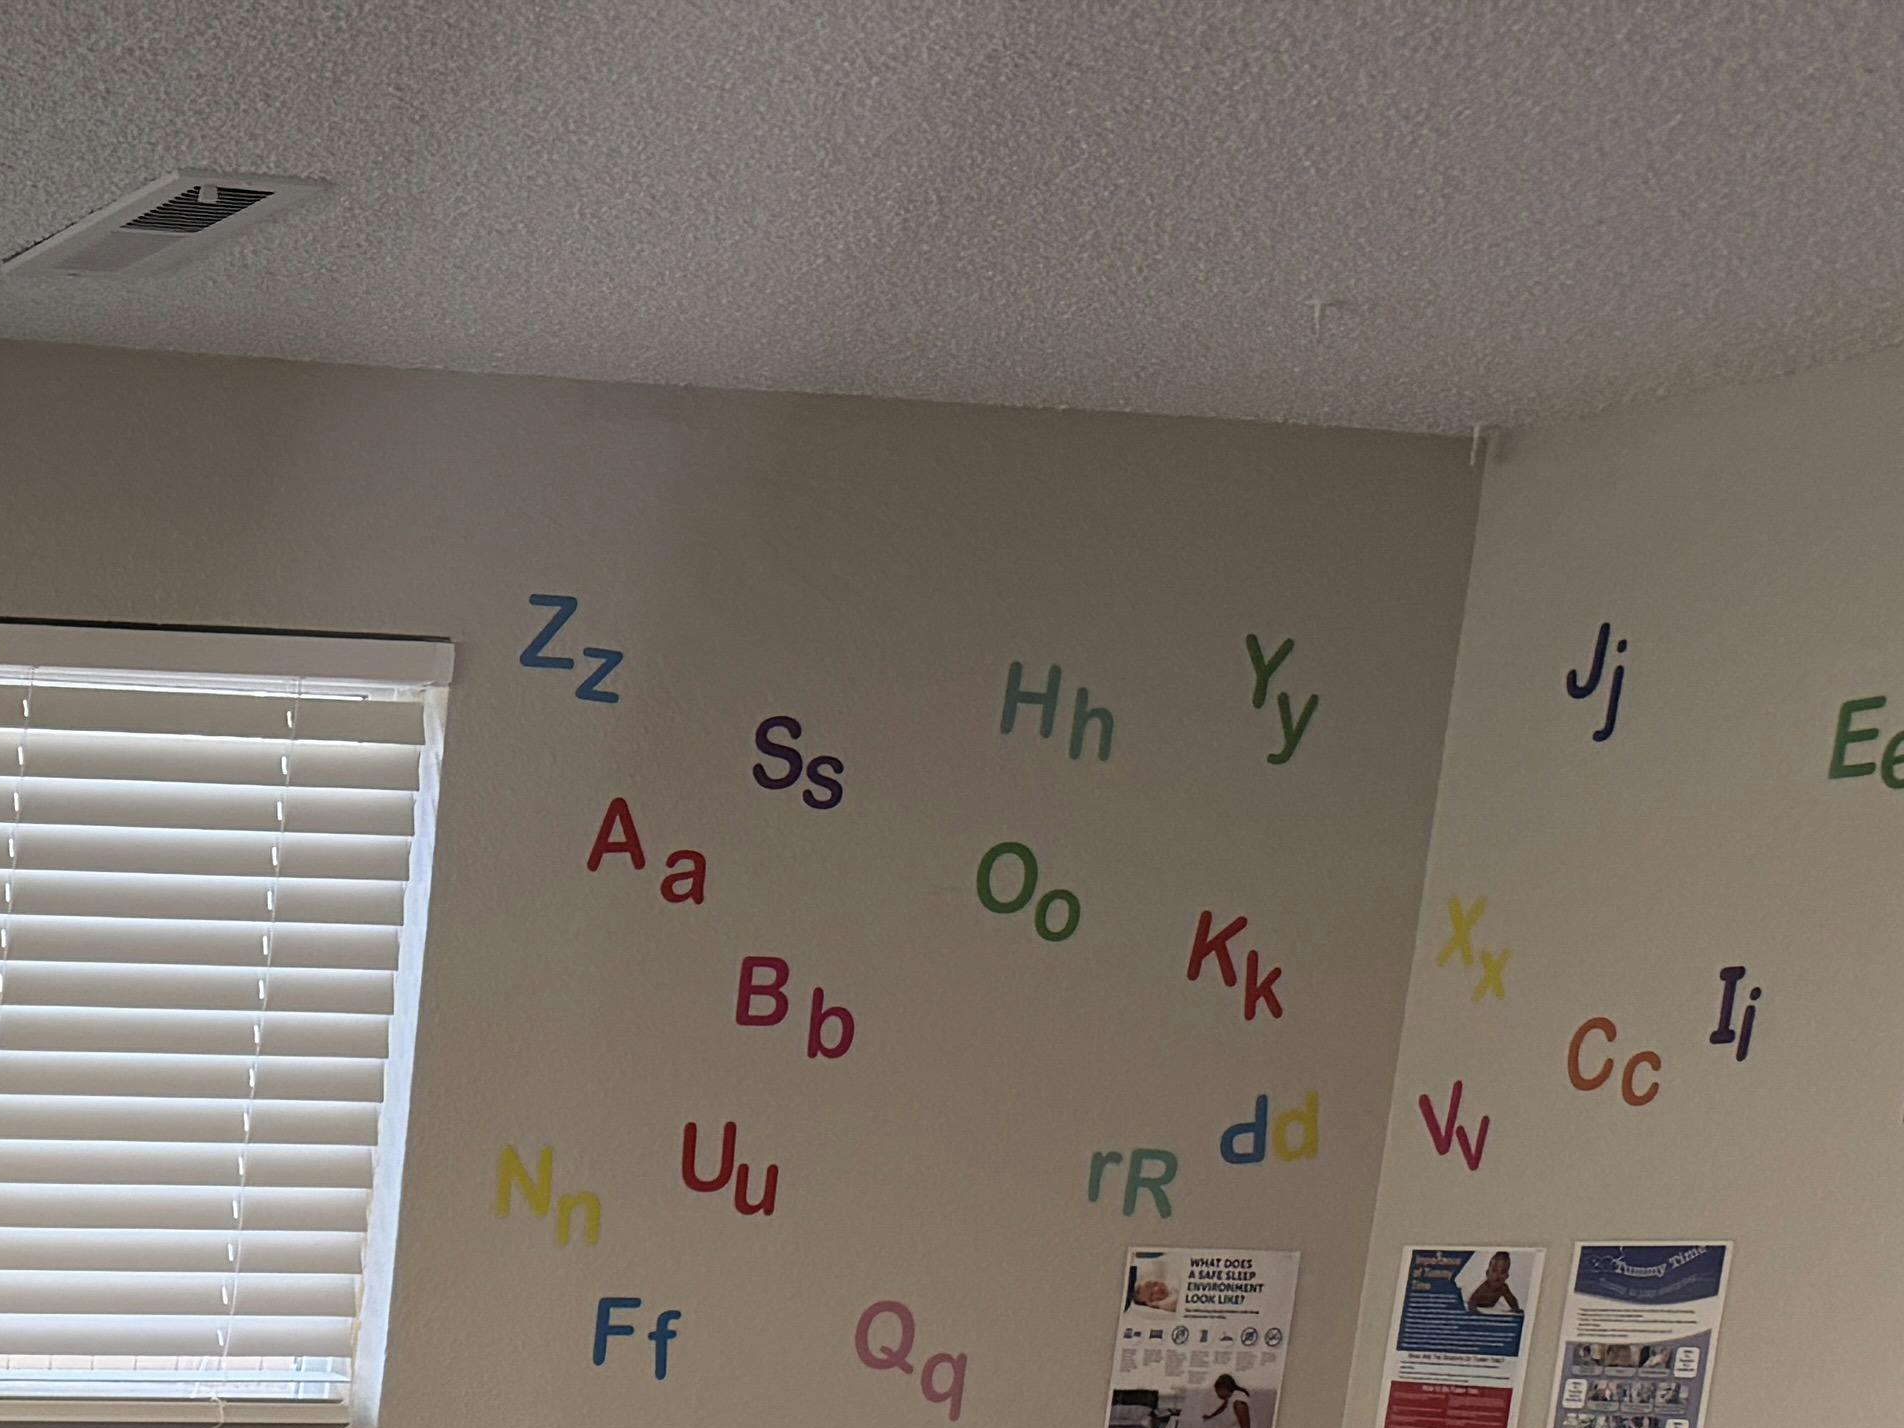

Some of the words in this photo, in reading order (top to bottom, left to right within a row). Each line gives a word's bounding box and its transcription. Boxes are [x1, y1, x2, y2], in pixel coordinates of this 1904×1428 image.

[1190, 1258, 1222, 1269] WHAT
[1224, 1259, 1253, 1269] DOES
[1614, 1258, 1667, 1278] Tummy
[1188, 1270, 1196, 1279] A
[1198, 1270, 1223, 1280] SAFE
[1225, 1271, 1256, 1281] SLEEP
[1187, 1282, 1264, 1293] ENVIRONMENT
[1185, 1294, 1215, 1305] LOOK
[1218, 1295, 1245, 1305] LIKE?
